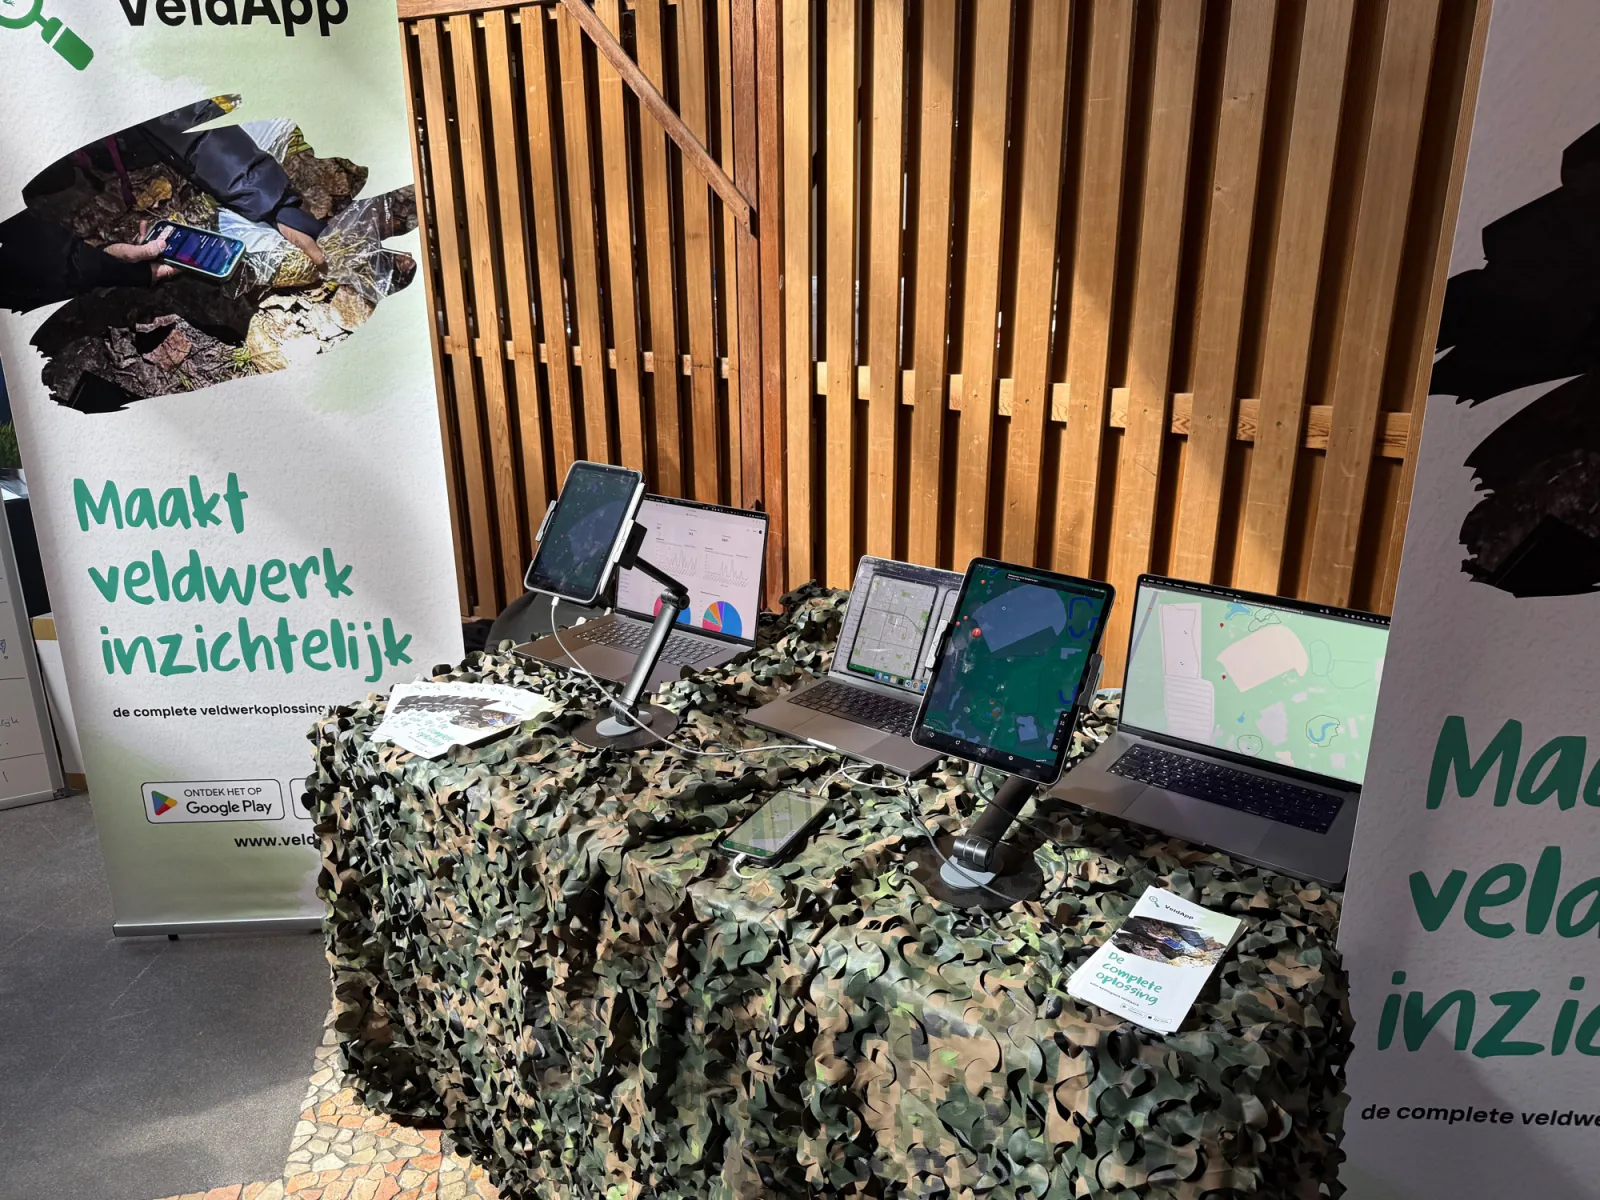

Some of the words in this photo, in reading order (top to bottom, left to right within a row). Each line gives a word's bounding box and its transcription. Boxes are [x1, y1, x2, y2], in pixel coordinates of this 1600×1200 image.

[73, 472, 249, 535] Maakt
[88, 547, 354, 606] veldwerk
[99, 617, 413, 683] inzichtelijk
[112, 706, 131, 718] de
[133, 704, 198, 719] complete
[183, 788, 226, 798] ONTDEK
[226, 787, 246, 797] HET
[247, 786, 263, 796] OP
[185, 800, 241, 817] Google
[242, 799, 273, 816] Play
[1108, 952, 1125, 964] De
[1095, 972, 1159, 1006] oplossing
[1102, 963, 1163, 993] complete
[1360, 1103, 1391, 1121] de
[1396, 1106, 1515, 1125] complete
